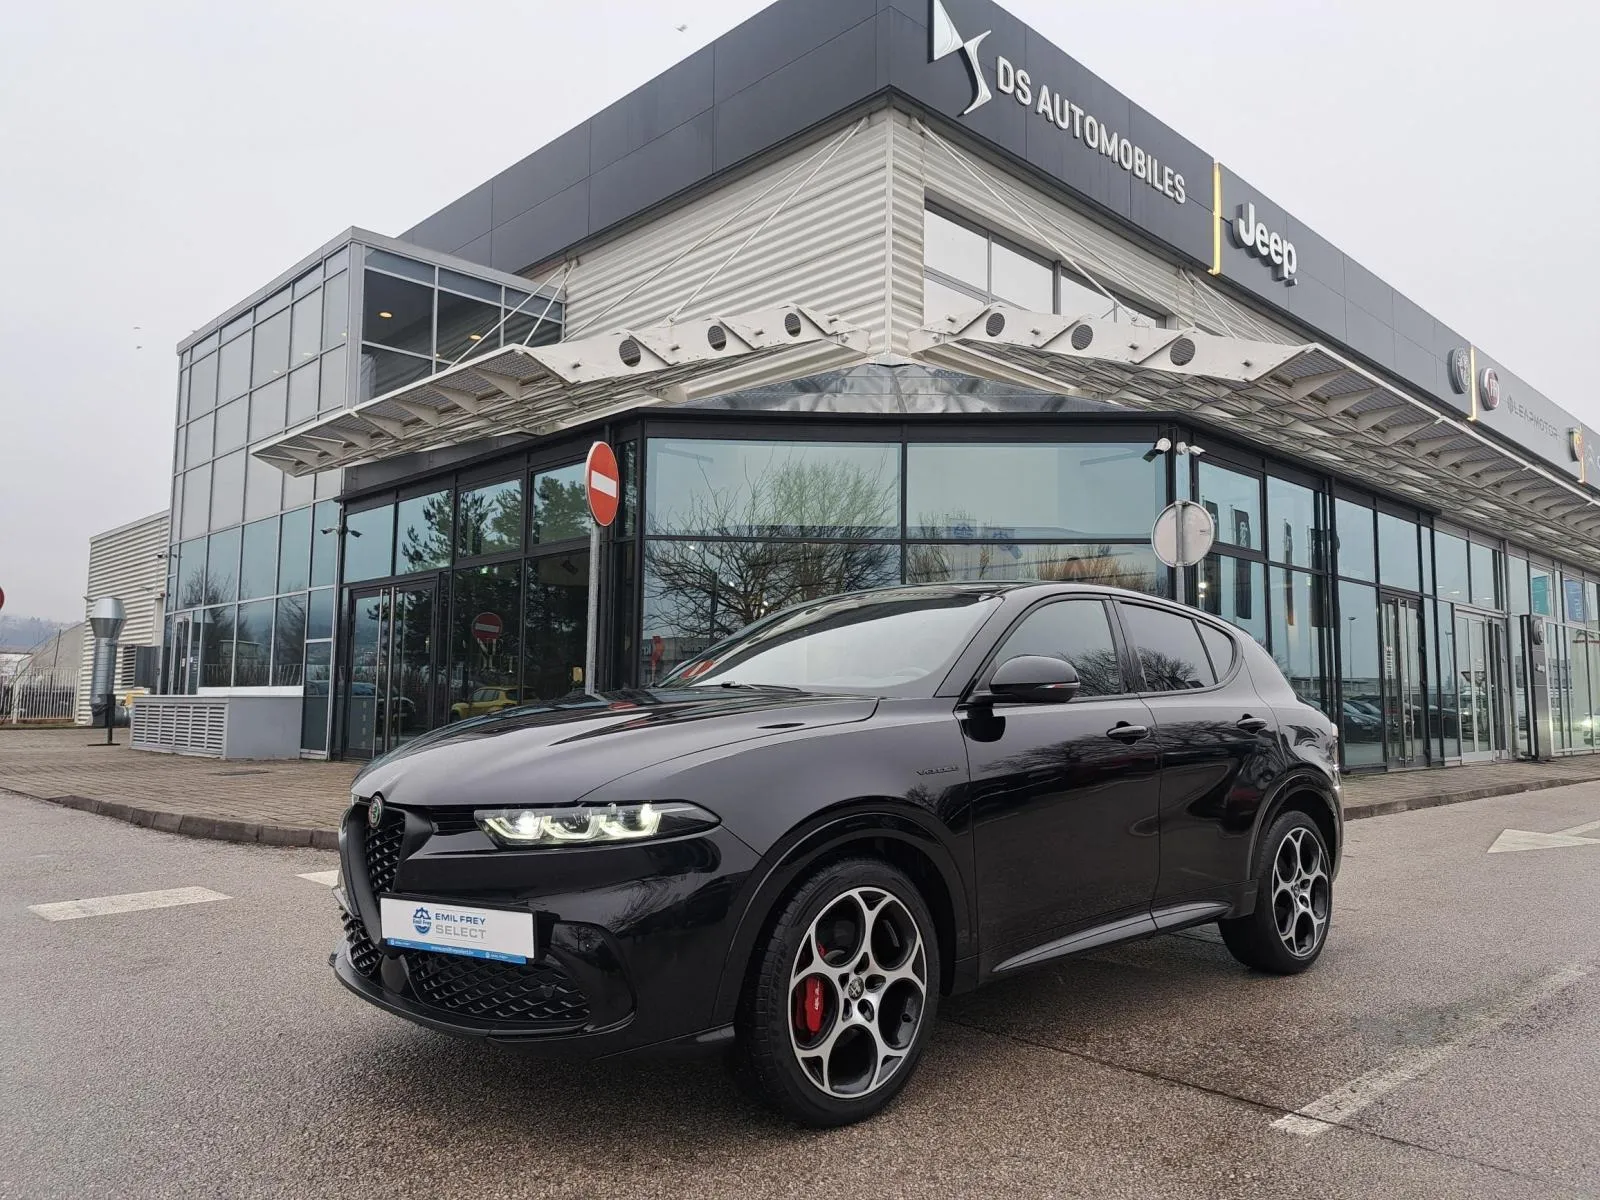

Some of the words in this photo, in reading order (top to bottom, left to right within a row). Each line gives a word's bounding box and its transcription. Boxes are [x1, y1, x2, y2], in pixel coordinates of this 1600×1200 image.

[996, 55, 1032, 106] DS
[1035, 84, 1186, 204] AUTOMOBILES
[1234, 201, 1298, 278] Jeep
[435, 912, 458, 923] EMIL
[460, 915, 486, 926] FREY
[435, 925, 487, 939] SELECT
